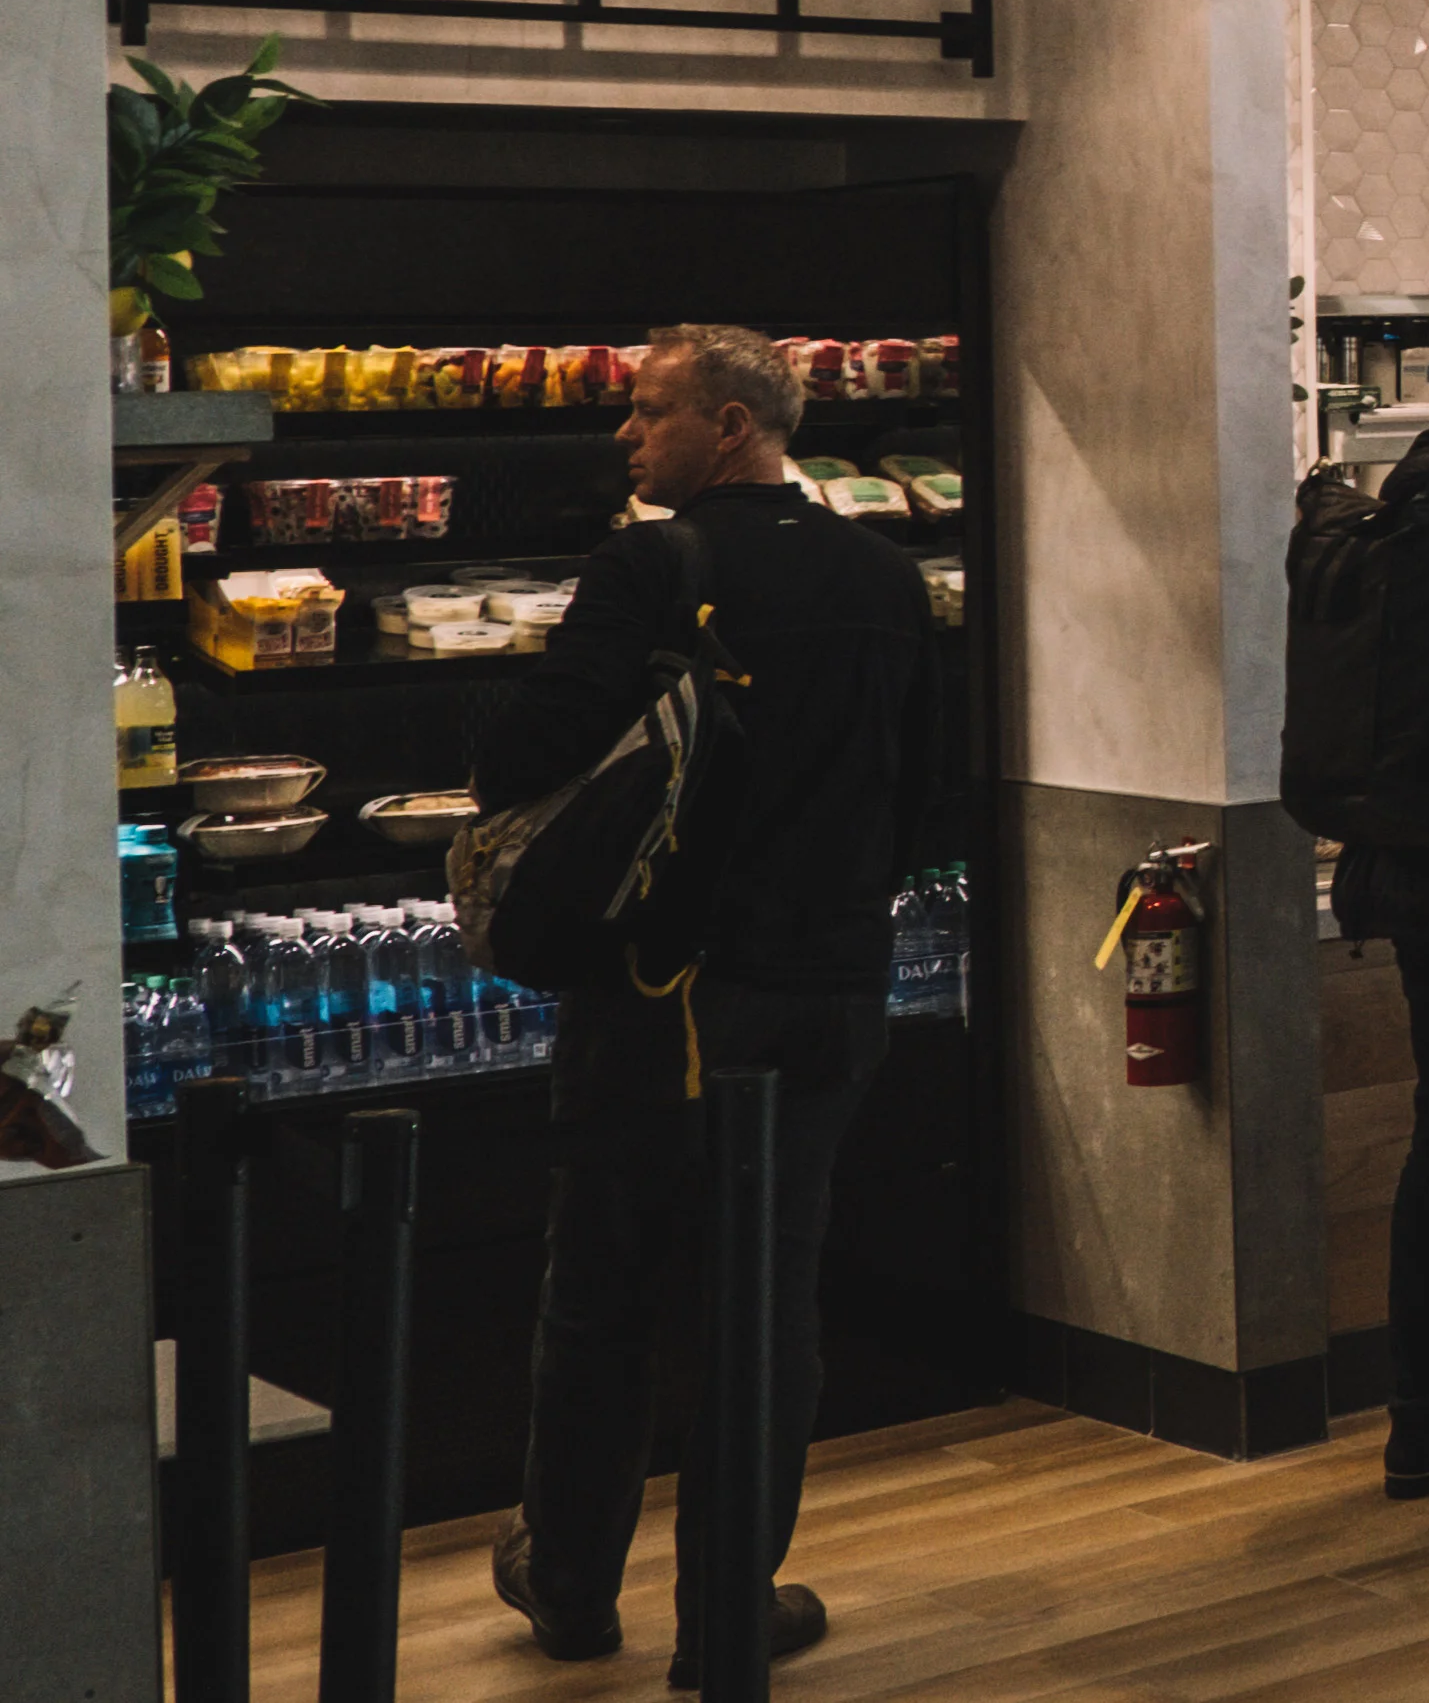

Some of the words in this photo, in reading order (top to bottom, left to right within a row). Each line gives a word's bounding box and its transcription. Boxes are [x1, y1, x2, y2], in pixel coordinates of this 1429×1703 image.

[154, 532, 169, 592] DROUGHT
[347, 1021, 364, 1062] smart
[402, 1014, 417, 1055] smart
[450, 1010, 465, 1049] smart
[495, 1003, 512, 1042] smart
[300, 1026, 315, 1069] smart
